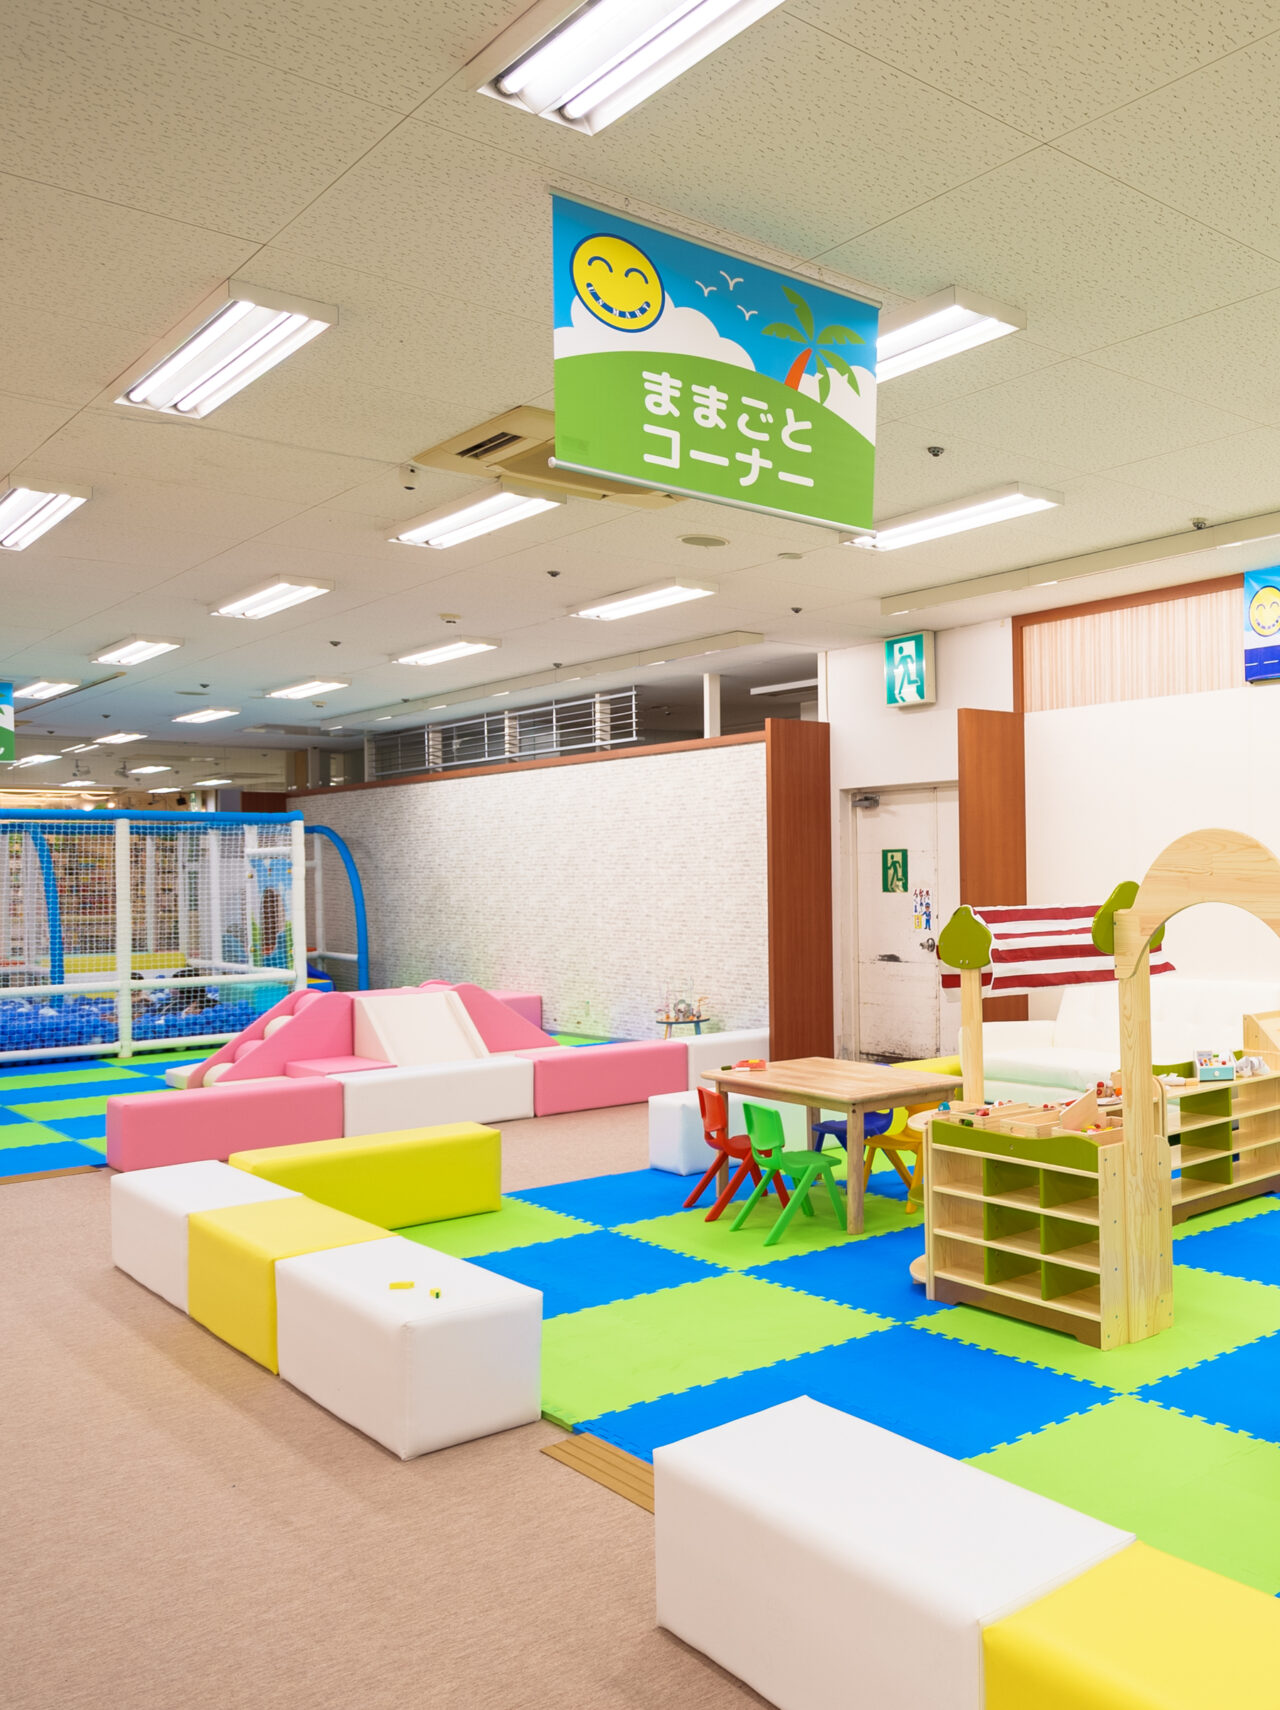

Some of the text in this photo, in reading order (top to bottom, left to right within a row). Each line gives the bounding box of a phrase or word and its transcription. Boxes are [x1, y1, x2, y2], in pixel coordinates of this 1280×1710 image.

[642, 371, 812, 453] ままごと
[643, 423, 814, 487] コーナー
